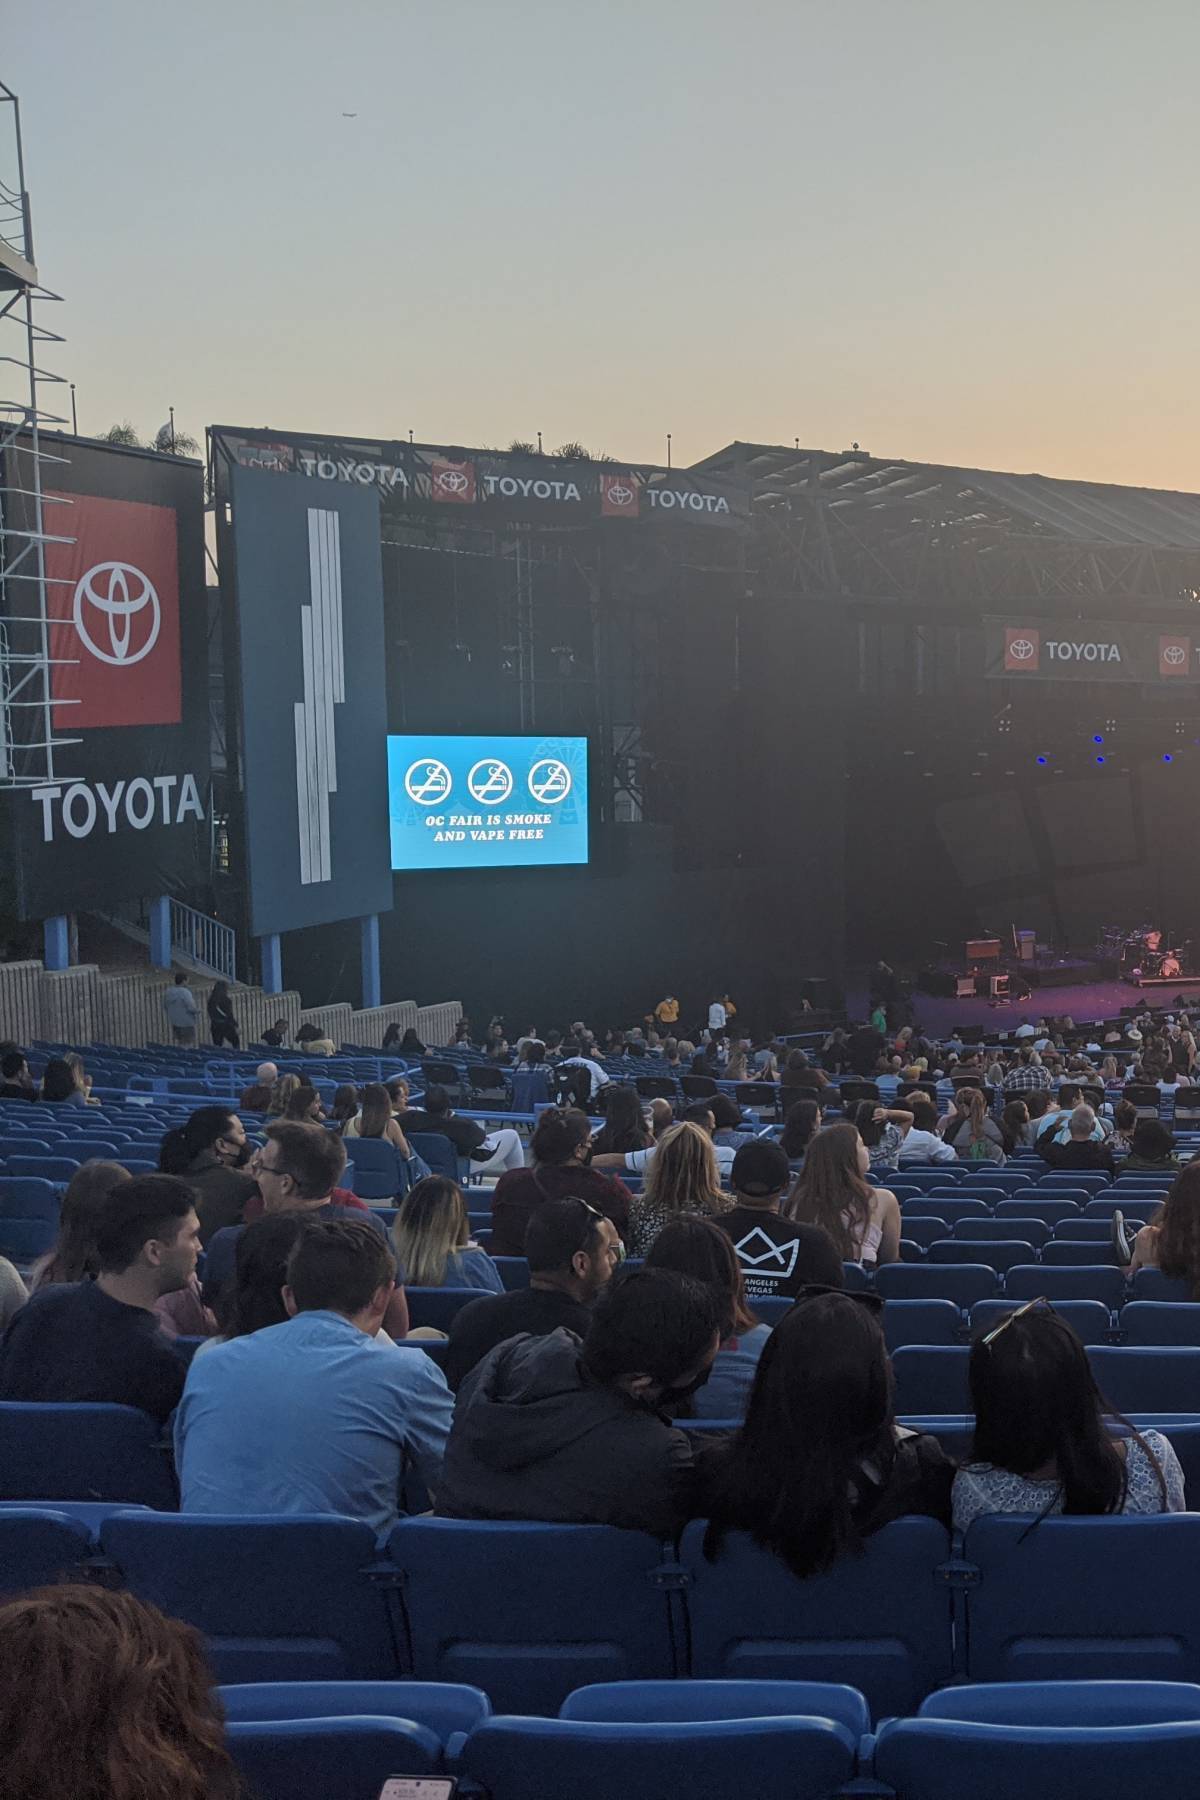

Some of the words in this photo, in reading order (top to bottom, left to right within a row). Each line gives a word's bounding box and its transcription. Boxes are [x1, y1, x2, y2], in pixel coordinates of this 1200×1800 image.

[300, 458, 410, 487] TOYOTA
[484, 475, 582, 502] TOYOTA
[646, 489, 731, 514] TOYOTA
[1046, 641, 1121, 662] TOYOTA
[31, 773, 206, 843] TOYOTA
[425, 815, 445, 827] OC
[449, 815, 483, 826] FAIR
[486, 815, 501, 826] IS
[504, 814, 552, 825] SMOKE
[433, 830, 466, 842] AND
[469, 830, 505, 841] VAPE
[508, 829, 544, 840] FREE
[744, 1278, 779, 1287] ANGELES
[747, 1286, 773, 1294] VEGAS
